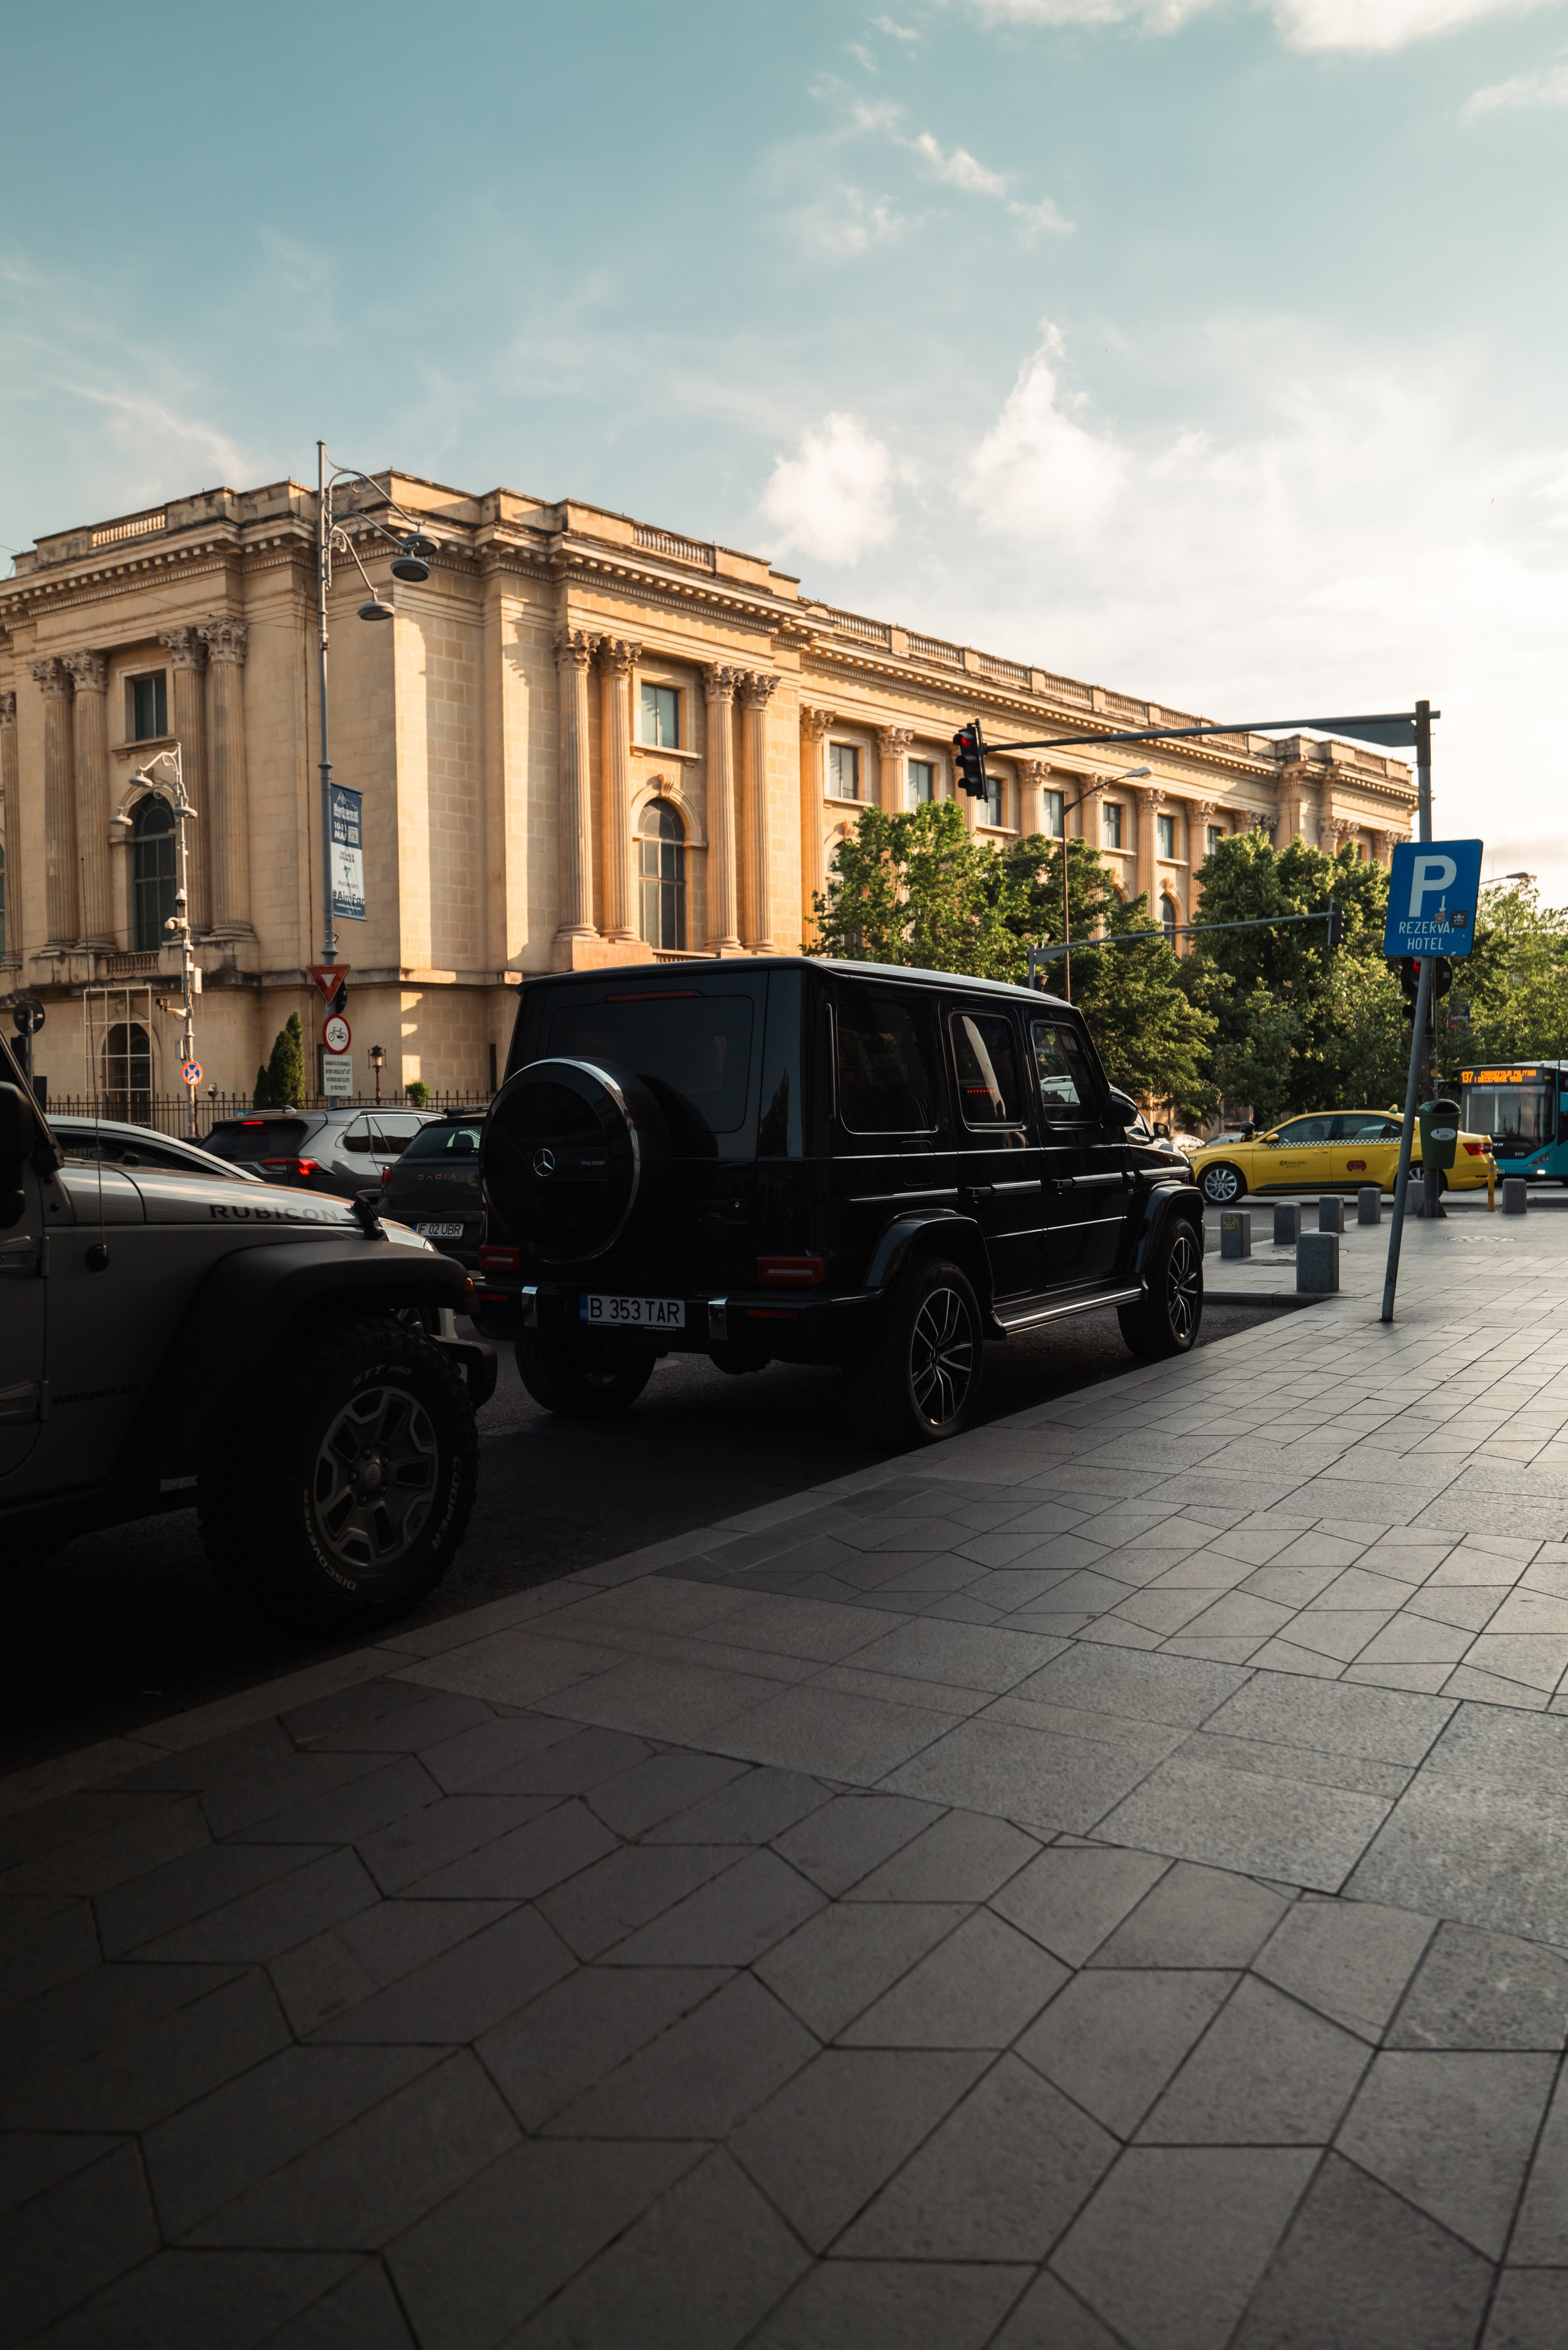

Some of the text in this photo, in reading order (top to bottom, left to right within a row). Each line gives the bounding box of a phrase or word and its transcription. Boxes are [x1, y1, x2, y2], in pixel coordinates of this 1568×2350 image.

[334, 803, 358, 818] Bucharest
[334, 821, 347, 832] 10-11
[337, 879, 358, 889] Autonom
[1409, 855, 1457, 917] P
[1407, 938, 1444, 950] HOTEL
[1461, 1071, 1474, 1083] 137
[209, 1205, 339, 1221] RUBICON
[418, 1224, 461, 1235] IF 02 UBR
[581, 1297, 680, 1324] RO B 353 TAR
[352, 1364, 412, 1388] STT PRO
[52, 1384, 141, 1406] WRANGLER
[431, 1456, 460, 1550] COOPER
